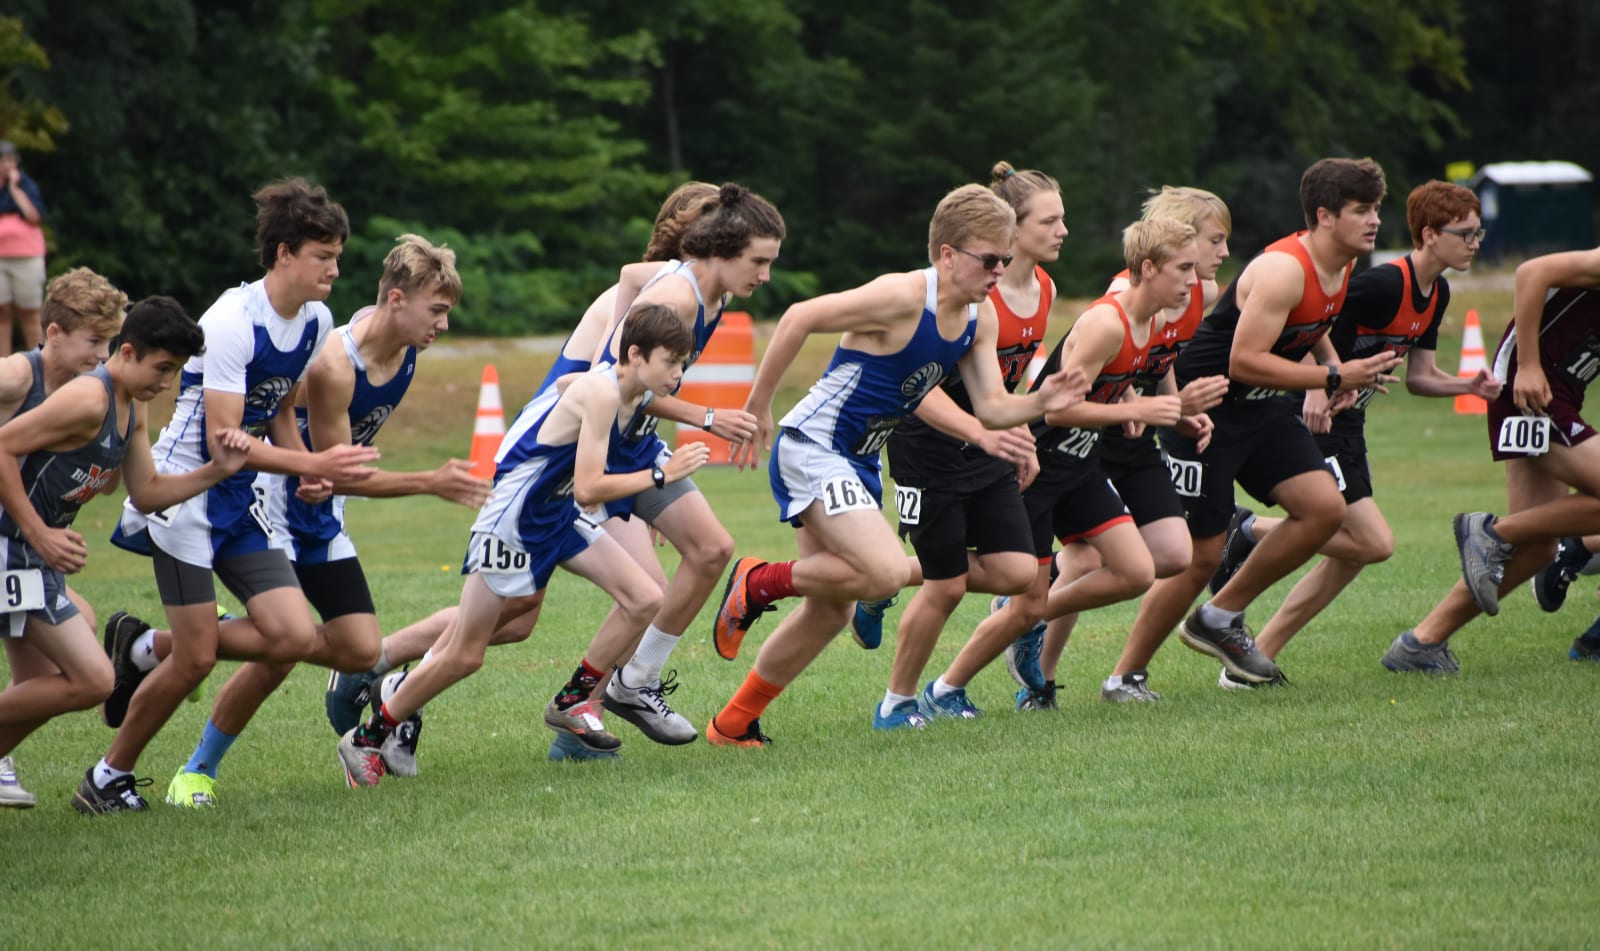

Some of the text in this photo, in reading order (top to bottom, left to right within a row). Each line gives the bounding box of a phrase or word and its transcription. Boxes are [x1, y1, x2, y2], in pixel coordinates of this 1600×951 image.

[1057, 427, 1099, 459] 226
[1502, 420, 1545, 449] 106
[1167, 462, 1198, 493] 20
[825, 479, 872, 510] 163
[896, 490, 918, 519] 22
[6, 574, 22, 607] 9
